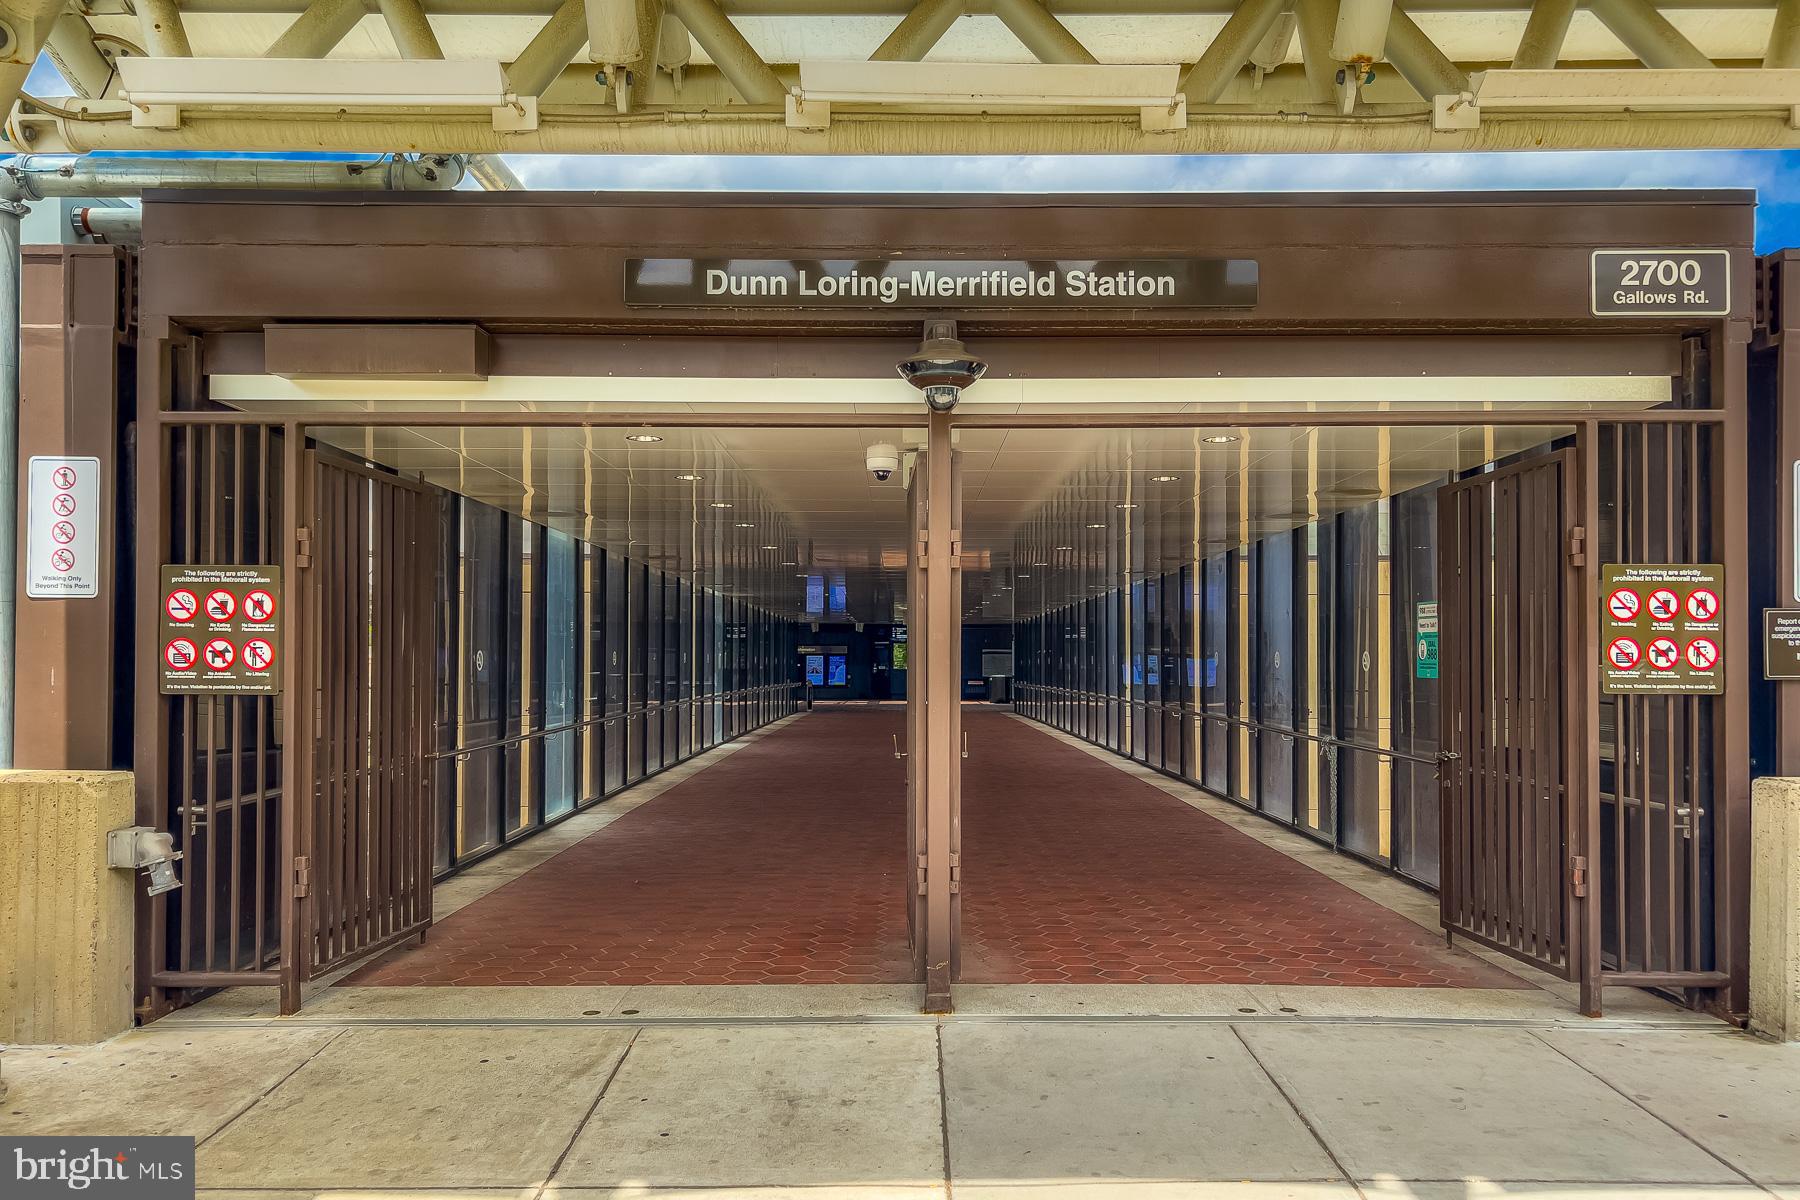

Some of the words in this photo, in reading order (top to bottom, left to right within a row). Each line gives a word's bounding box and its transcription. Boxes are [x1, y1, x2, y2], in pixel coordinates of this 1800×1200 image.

[1620, 259, 1701, 286] 2700
[706, 269, 787, 296] Dunn
[799, 269, 1055, 303] Loring-Merrifield
[1066, 269, 1175, 297] Station
[1613, 290, 1677, 304] Gallows
[1684, 290, 1709, 304] Rd.
[197, 570, 225, 578] following
[1638, 569, 1667, 577] following
[1679, 569, 1701, 577] strictly
[41, 575, 66, 583] Walking
[67, 575, 82, 583] Only
[35, 582, 58, 590] Beyond
[1777, 618, 1797, 626] Report
[1427, 648, 1437, 660] 988
